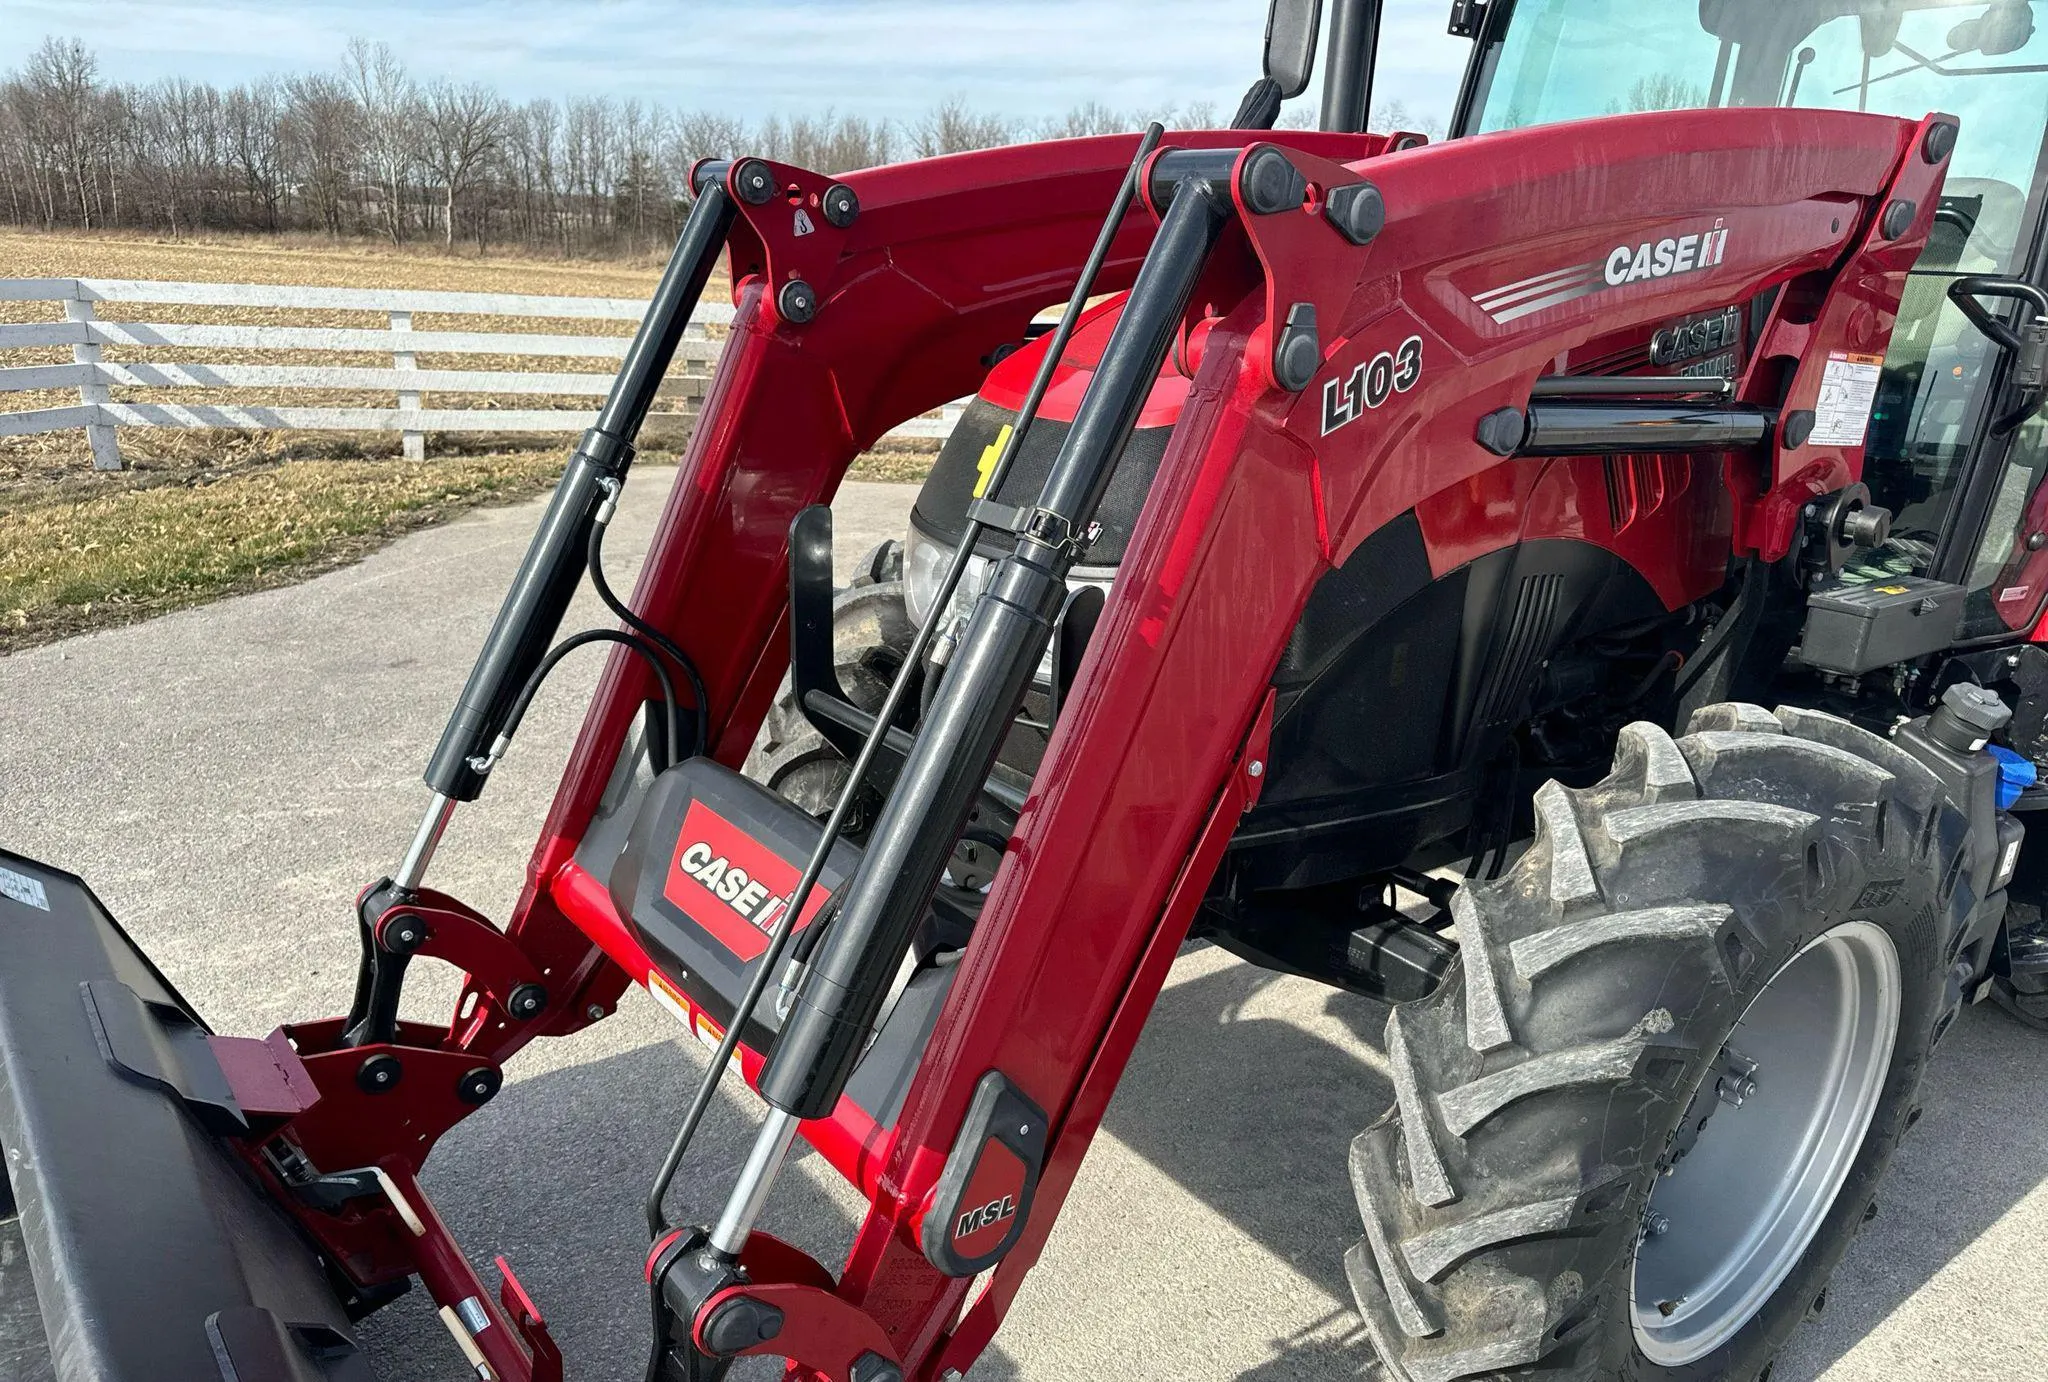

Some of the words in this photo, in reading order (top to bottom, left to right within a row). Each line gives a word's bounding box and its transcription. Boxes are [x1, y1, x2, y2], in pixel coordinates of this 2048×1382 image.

[1604, 234, 1699, 286] CASE
[1650, 317, 1723, 368] CASE
[1321, 335, 1423, 437] L103
[679, 842, 771, 918] CASE
[954, 1193, 1016, 1240] MSL
